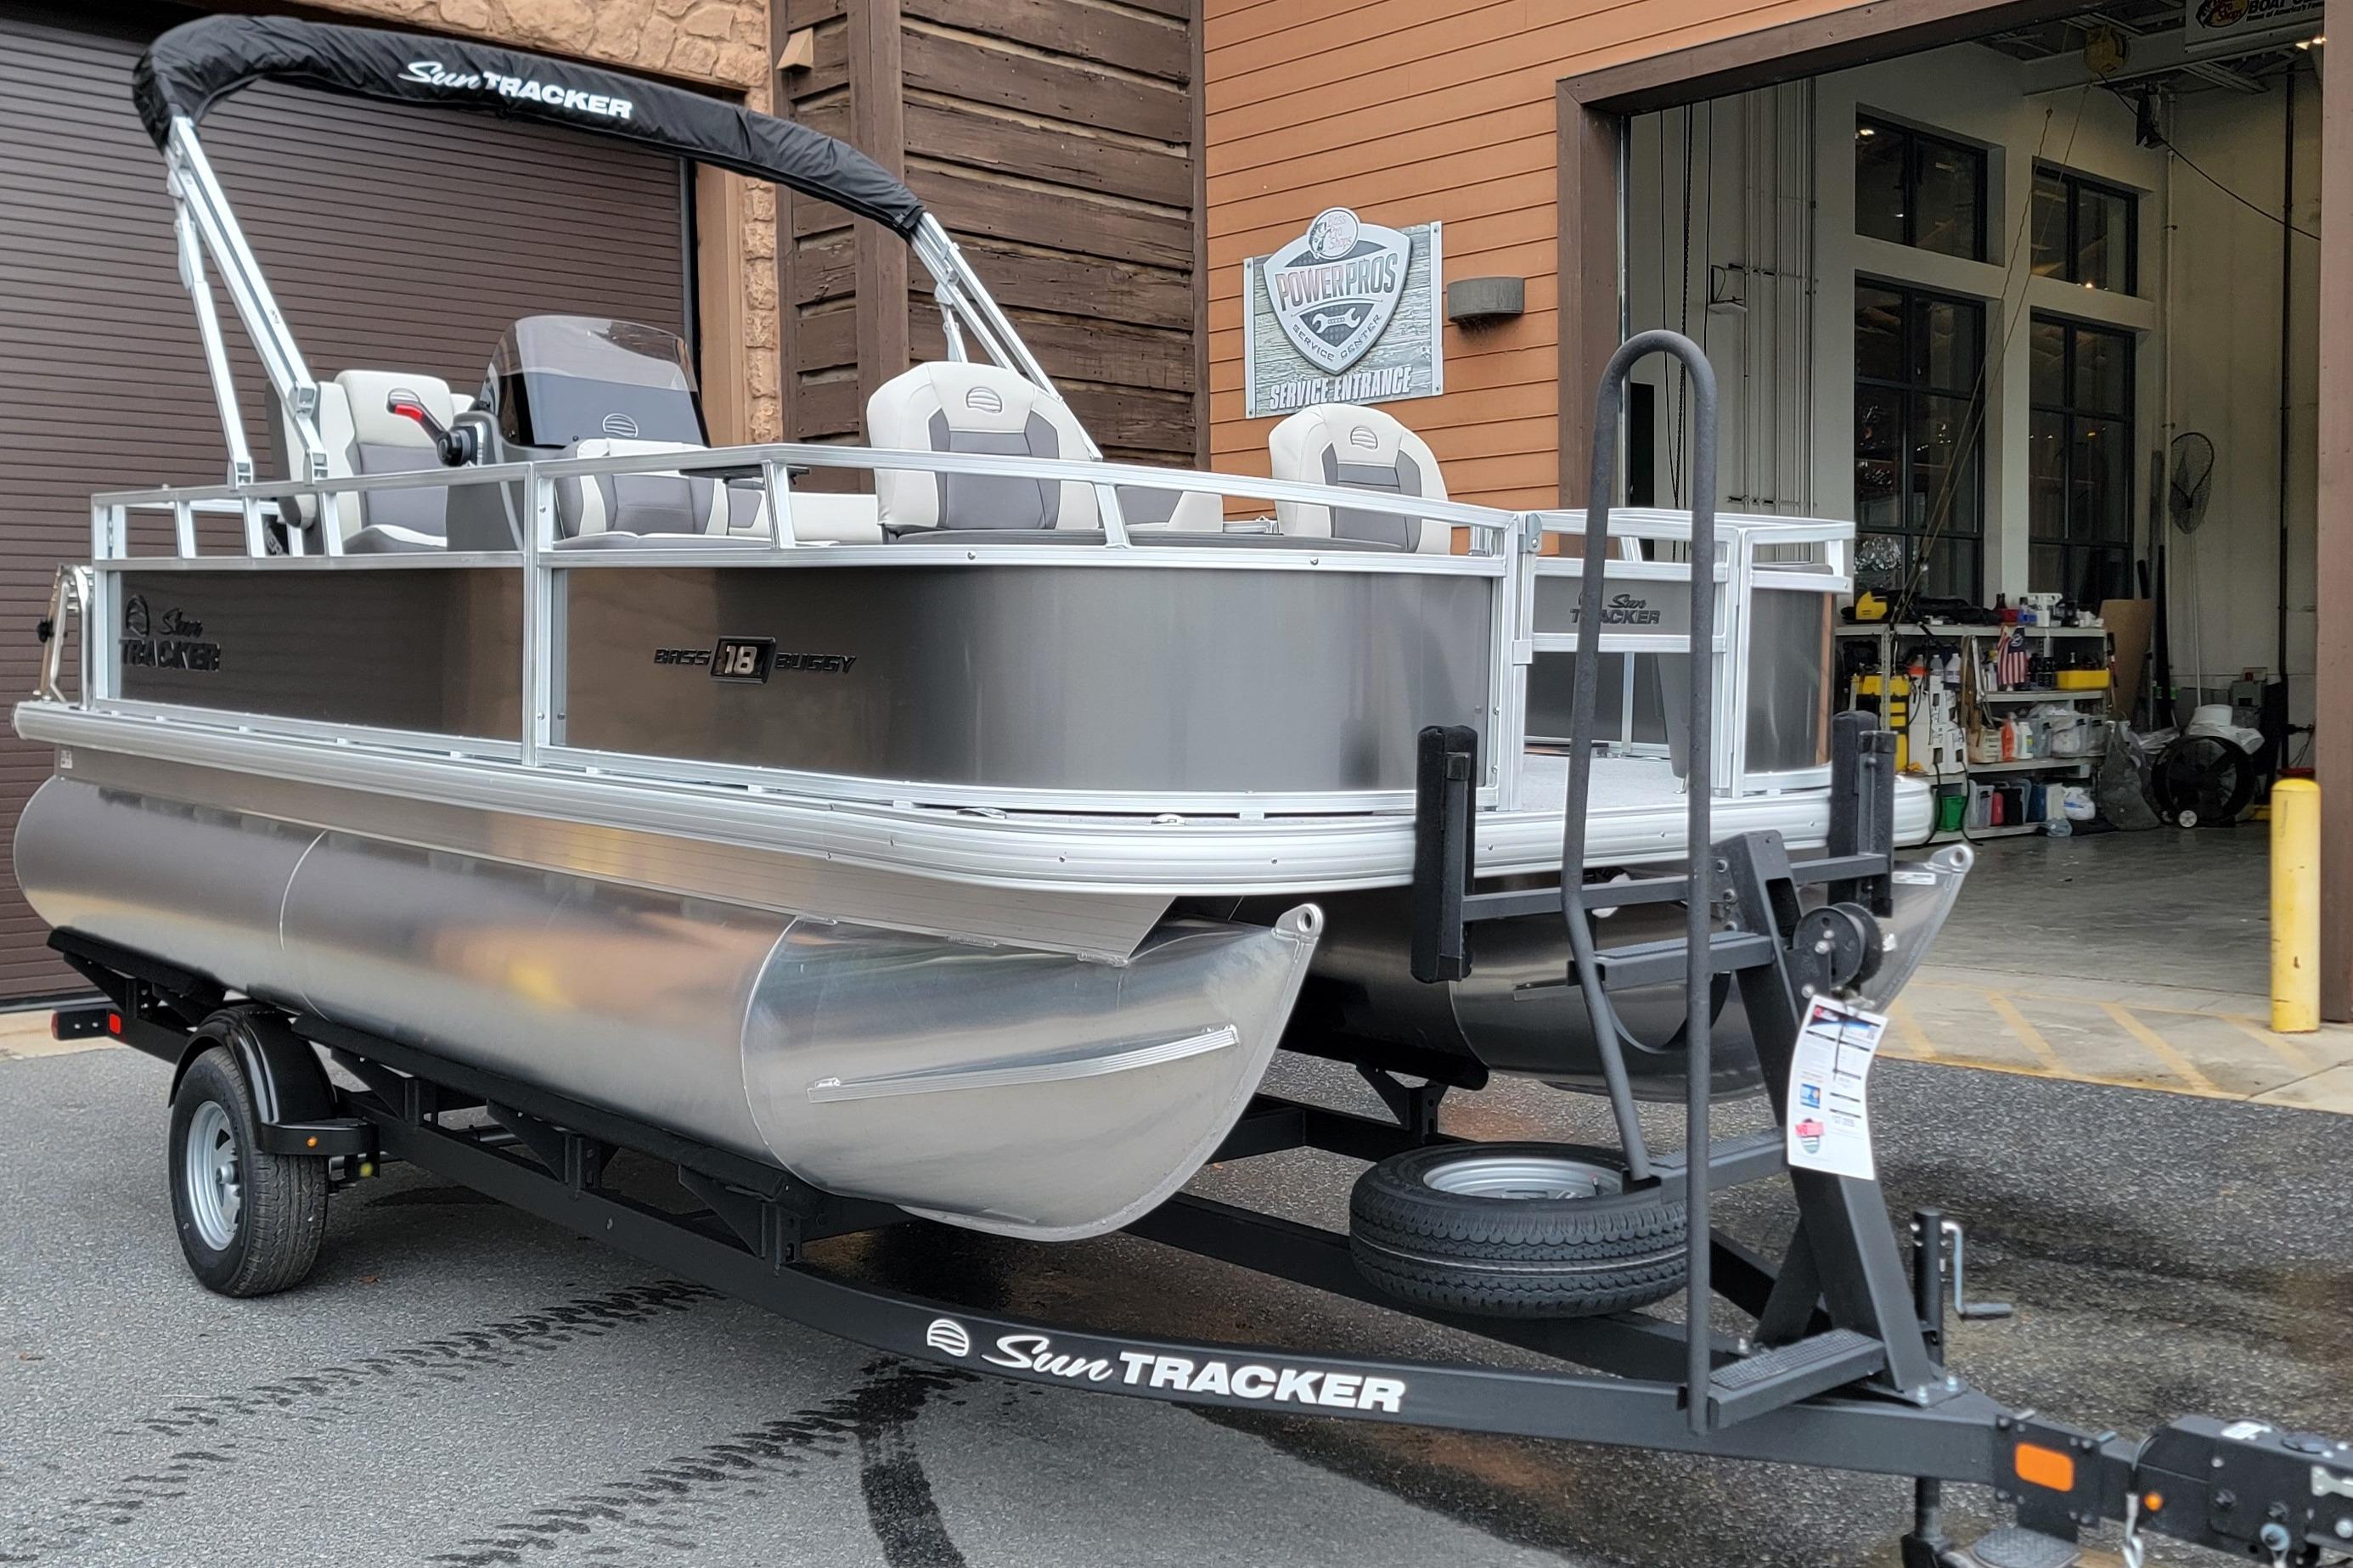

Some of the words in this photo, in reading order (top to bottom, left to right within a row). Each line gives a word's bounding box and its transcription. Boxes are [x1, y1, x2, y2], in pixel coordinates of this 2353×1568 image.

[397, 60, 482, 90] Sun
[482, 70, 633, 119] TRACKER
[1292, 323, 1335, 362] SERVICE
[1340, 313, 1382, 360] CENTER
[1269, 376, 1330, 411] SERVICE
[1333, 366, 1414, 402] ENTRANCE
[1570, 609, 1661, 624] TACKER
[1607, 593, 1647, 609] Sun
[159, 608, 203, 638] Sun
[120, 638, 221, 672] TRACKER
[654, 648, 712, 666] BASS
[724, 645, 757, 674] 18
[774, 652, 856, 673] BUGGY
[981, 1335, 1113, 1382] Sun
[1119, 1351, 1407, 1413] TRACKER
